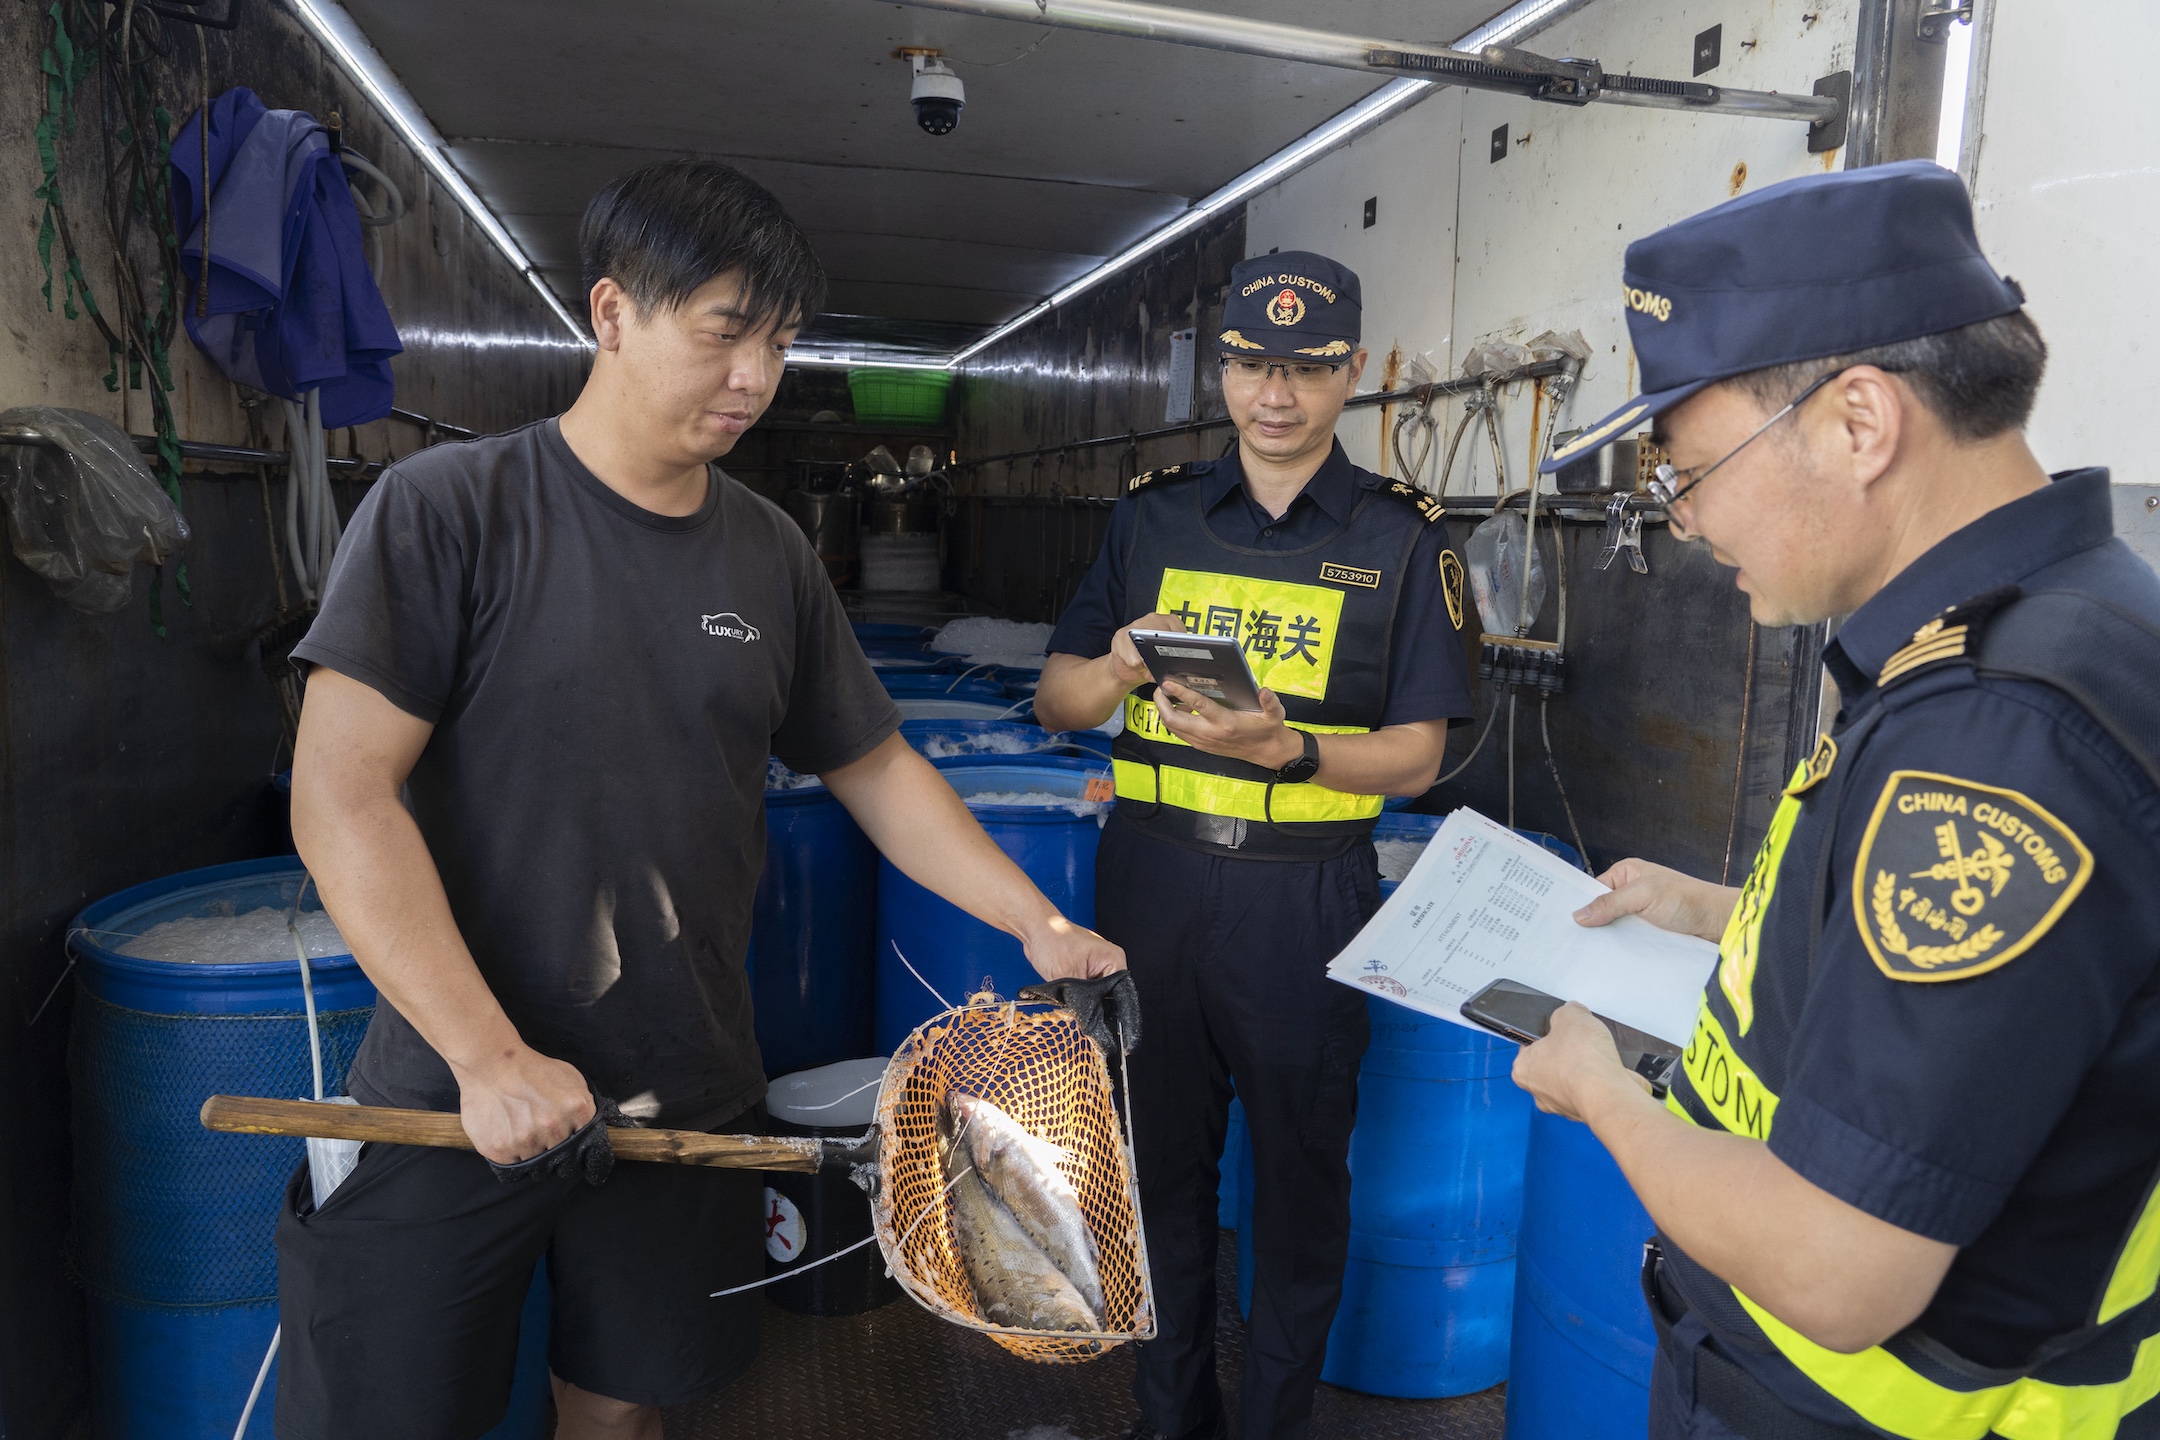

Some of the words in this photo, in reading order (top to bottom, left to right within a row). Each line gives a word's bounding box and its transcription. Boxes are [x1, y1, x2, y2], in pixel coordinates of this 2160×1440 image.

[1242, 275, 1275, 297] CHINA
[1278, 274, 1337, 304] CUSTOMS
[1623, 284, 1672, 322] TOMS
[1326, 568, 1374, 583] 5753910
[1170, 600, 1321, 666] 中国海关
[1454, 835, 1476, 861] ORIGINAL
[1898, 792, 1968, 816] CHINA
[1973, 803, 2067, 884] CUSTOMS
[1412, 901, 1435, 929] CERTIFICATE
[1437, 912, 1462, 942] ATTACHMENT
[1686, 1018, 1763, 1140] STOM
